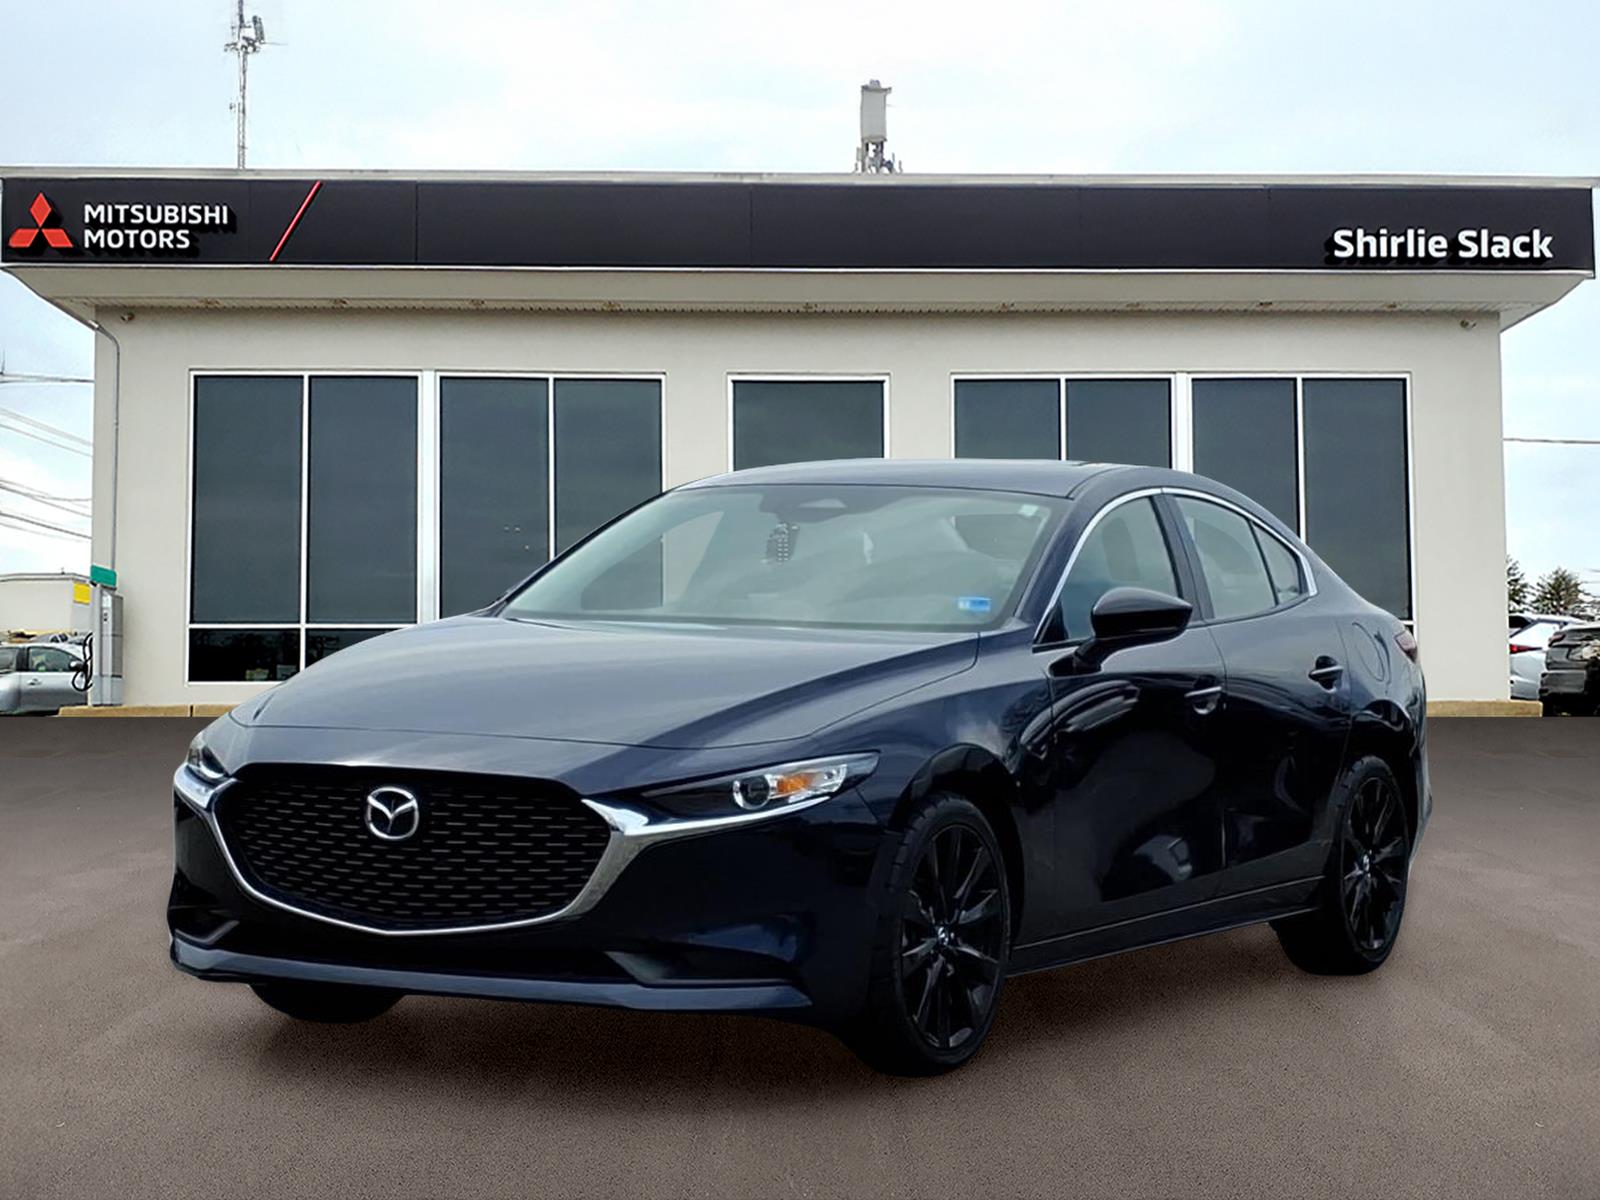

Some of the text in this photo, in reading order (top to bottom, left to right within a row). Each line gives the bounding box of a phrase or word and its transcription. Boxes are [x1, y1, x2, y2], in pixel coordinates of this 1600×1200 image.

[85, 205, 227, 224] MITSUBISHI
[85, 230, 189, 248] MOTORS
[1334, 229, 1553, 257] Shirlie Slack
